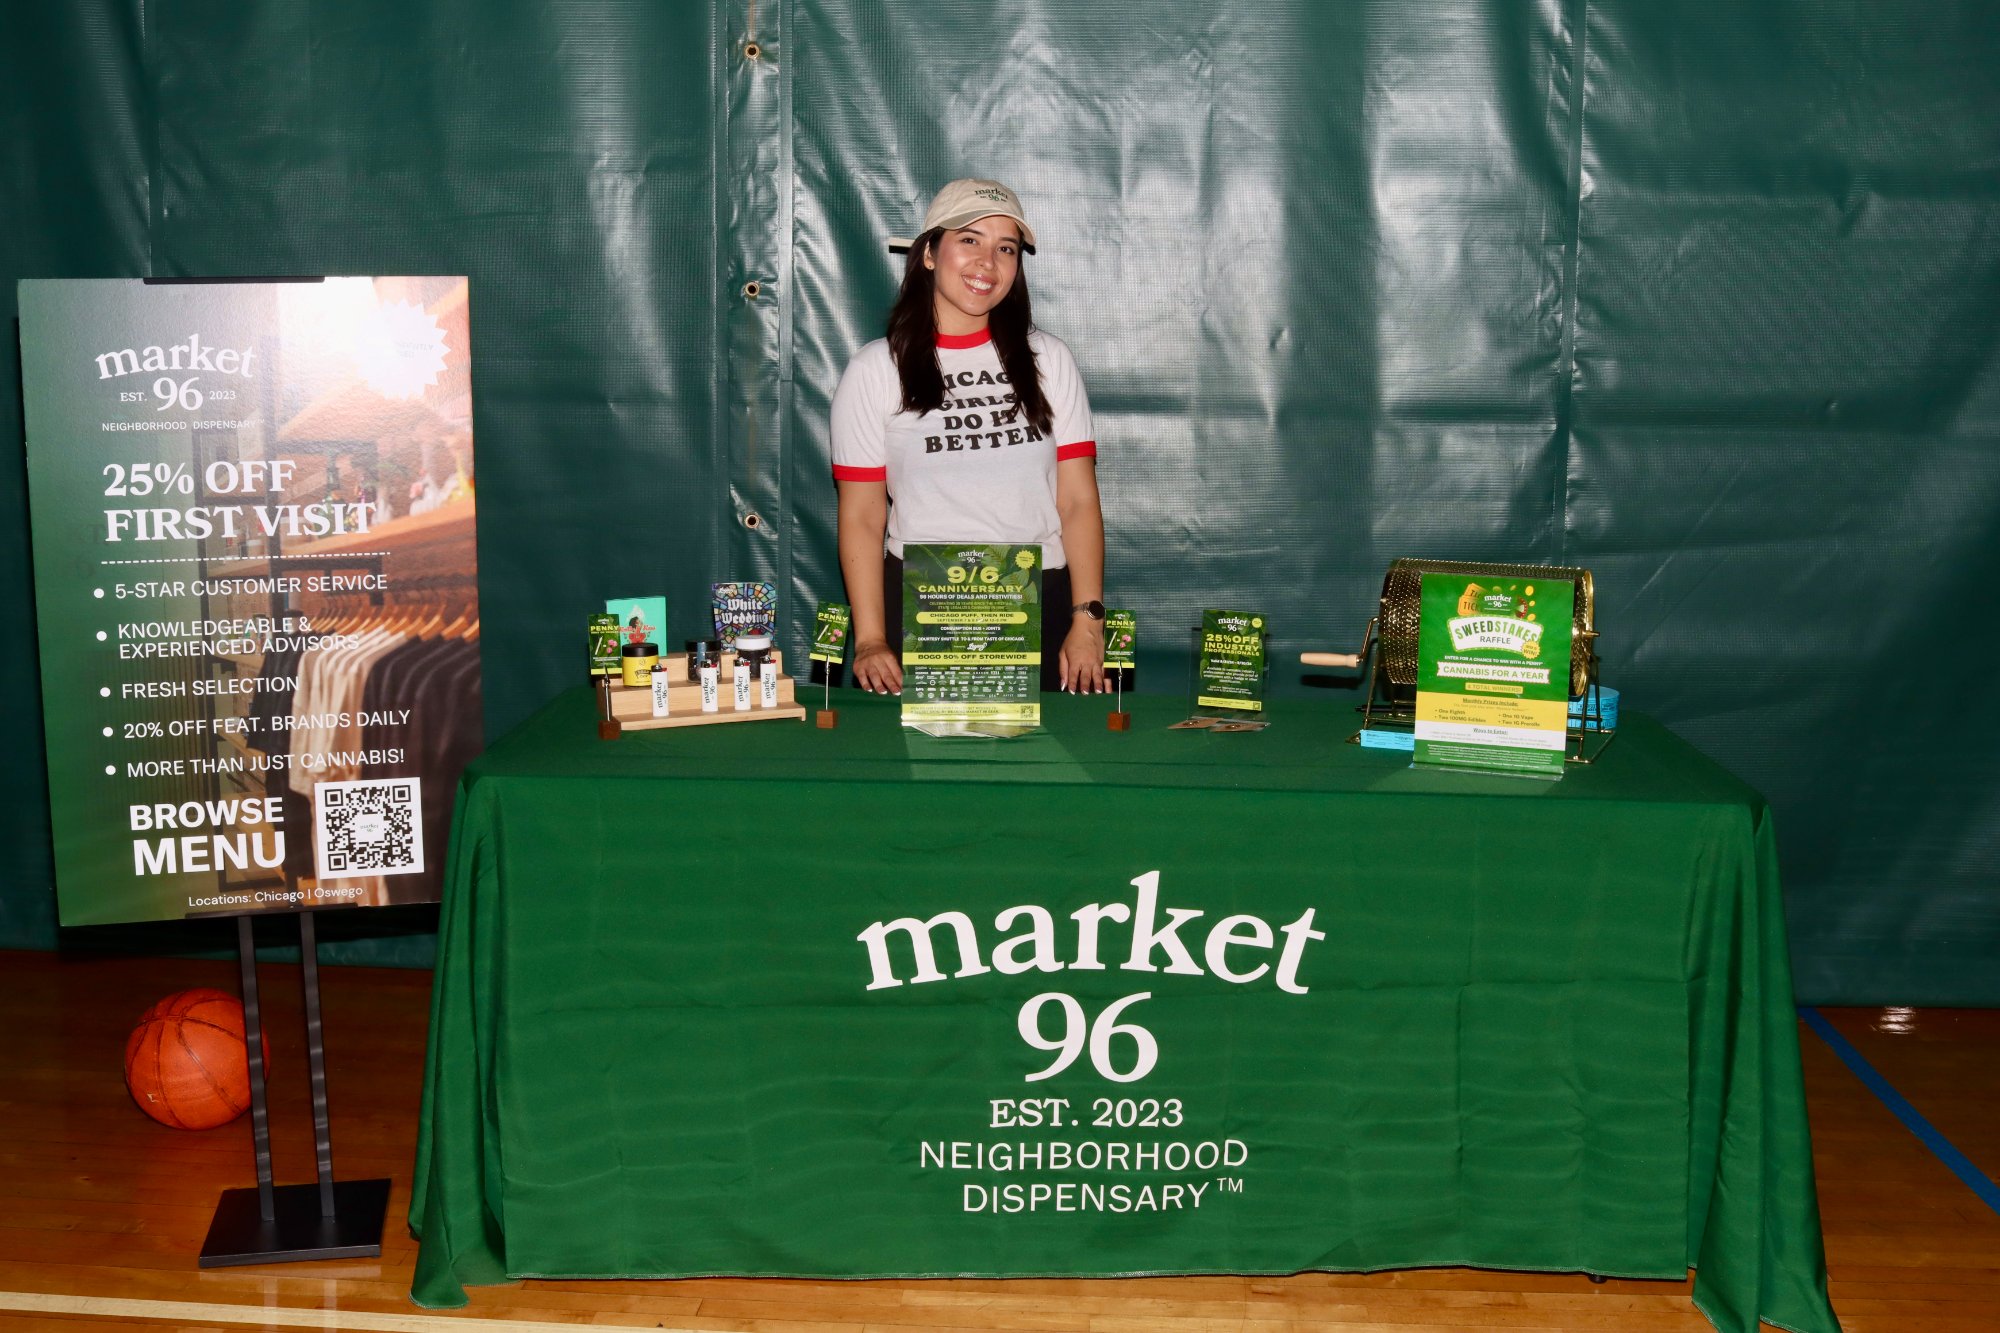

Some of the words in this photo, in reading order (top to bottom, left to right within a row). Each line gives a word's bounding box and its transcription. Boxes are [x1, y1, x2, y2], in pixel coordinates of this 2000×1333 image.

[974, 187, 1008, 200] market
[94, 332, 257, 380] market
[120, 392, 148, 402] EST.
[152, 376, 204, 412] 96
[209, 390, 237, 400] 2023
[102, 421, 187, 432] NEIGHBORHOOD
[943, 413, 983, 430] DO
[102, 462, 195, 497] 25%
[204, 459, 298, 494] OFF
[103, 505, 244, 542] FIRST
[252, 501, 377, 537] VISIT
[957, 549, 985, 558] market
[947, 565, 1000, 584] 9/6
[115, 581, 186, 599] 5-STAR
[190, 577, 301, 598] CUSTOMER
[306, 574, 389, 592] SERVICE
[918, 585, 1024, 593] CANNIVERSARY
[727, 598, 763, 611] White
[1483, 594, 1512, 603] market
[117, 617, 293, 639] KNOWLEDGEABLE
[298, 616, 312, 632] &
[721, 612, 769, 625] Wedding
[818, 612, 849, 622] PENNY
[1217, 616, 1248, 627] market
[1227, 624, 1237, 632] 96
[1454, 620, 1538, 642] SWEEDSTAKES
[1480, 635, 1511, 644] RAFFLE
[119, 638, 256, 660] EXPERIENCED
[260, 634, 360, 654] ADVISORS
[1204, 641, 1260, 652] INDUSTRY
[1204, 647, 1260, 656] PROFESSIONALS
[1443, 666, 1490, 676] CANNABIS
[1491, 669, 1509, 678] FOR
[1511, 670, 1518, 678] A
[1520, 671, 1544, 680] YEAR
[121, 680, 187, 699] FRESH
[191, 676, 301, 696] SELECTION
[123, 721, 164, 739] 20%
[168, 719, 208, 736] OFF
[212, 716, 266, 735] FEAT.
[271, 712, 350, 732] BRANDS
[355, 709, 411, 728] DAILY
[126, 759, 185, 778] MORE
[189, 755, 245, 775] THAN
[249, 753, 296, 772] JUST
[300, 748, 405, 769] CANNABIS!
[129, 796, 286, 831] BROWSE
[132, 830, 287, 876] MENU
[188, 891, 252, 907] Locations:
[254, 888, 304, 904] Chicago
[314, 885, 363, 900] Oswego
[856, 870, 1326, 995] market
[1017, 991, 1159, 1083] 96
[989, 1098, 1079, 1128] EST.
[1091, 1098, 1184, 1128] 2023
[919, 1139, 1249, 1172] NEIGHBORHOOD
